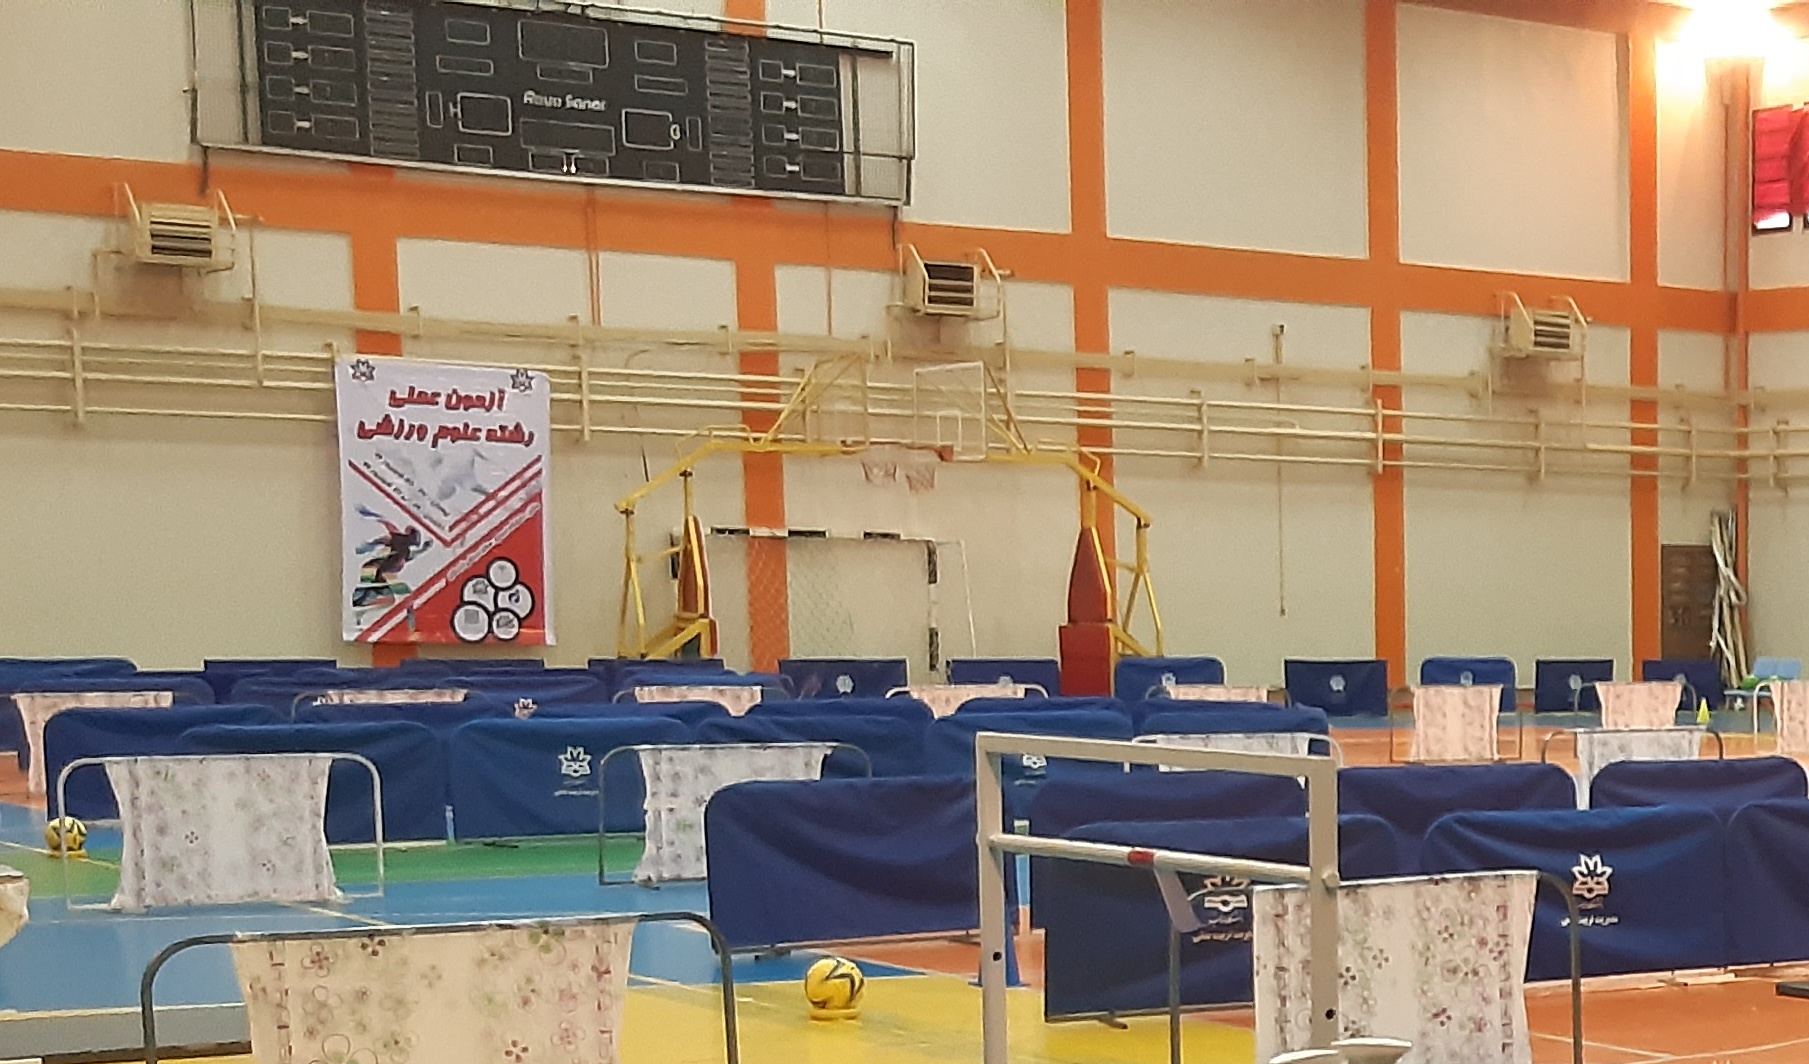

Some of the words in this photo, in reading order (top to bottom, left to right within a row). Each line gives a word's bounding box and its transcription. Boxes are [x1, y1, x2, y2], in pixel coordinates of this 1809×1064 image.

[388, 385, 442, 408] عملی
[445, 387, 507, 412] آزمون
[357, 413, 428, 440] ورزشی
[431, 421, 482, 448] علوم
[485, 421, 535, 447] رشته
